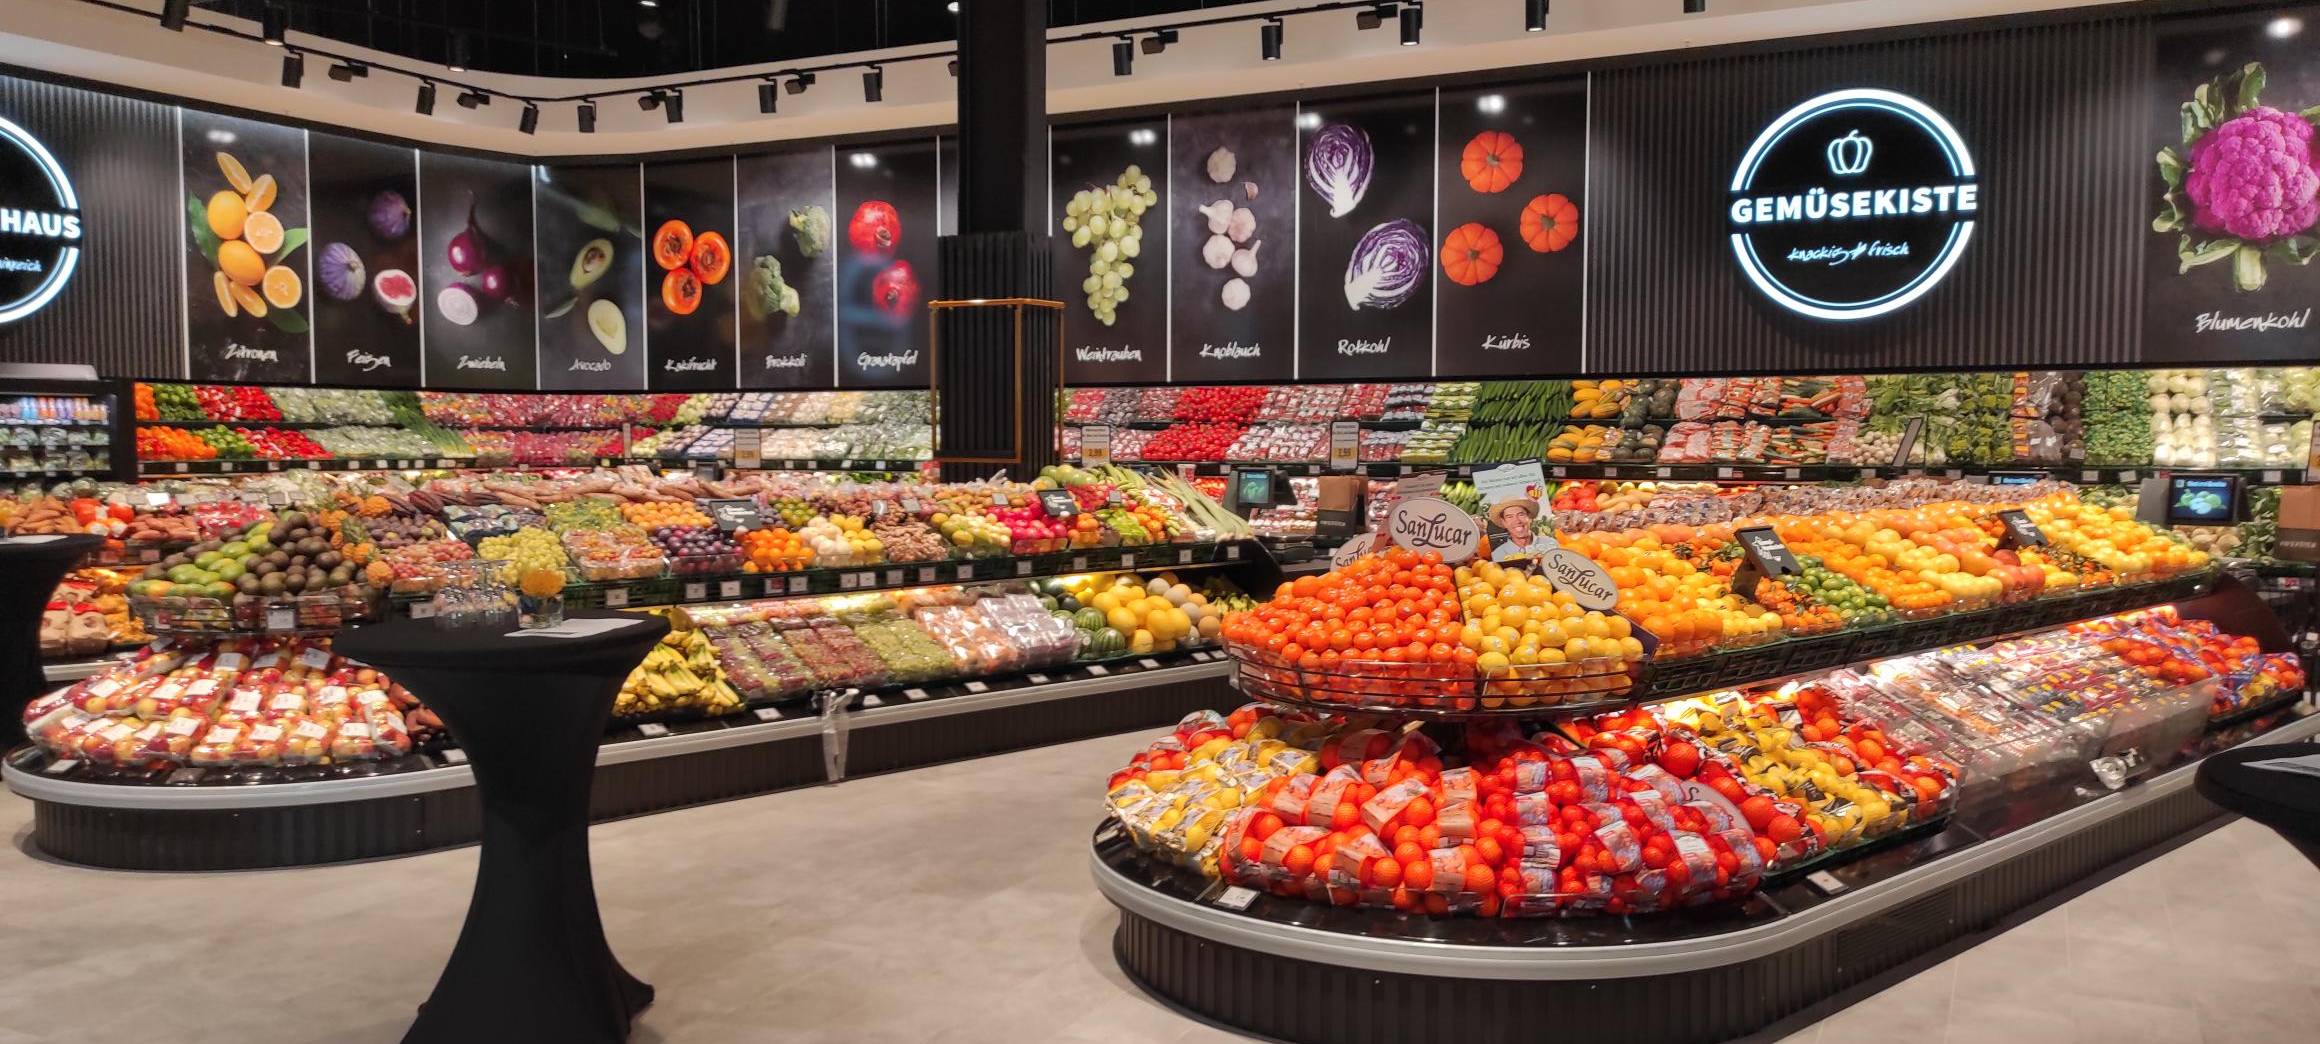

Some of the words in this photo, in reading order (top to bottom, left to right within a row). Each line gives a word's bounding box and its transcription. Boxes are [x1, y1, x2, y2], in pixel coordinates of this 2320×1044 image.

[1731, 184, 1978, 224] GEMÜSEKISTE
[0, 207, 81, 239] HAUS
[2195, 308, 2311, 333] Blumenkohl
[224, 343, 279, 362] Zitronen
[1076, 344, 1142, 362] Weintrauben
[1199, 341, 1261, 359] Knoblauch
[1481, 333, 1531, 350] Kürbis
[347, 349, 392, 372] Feigen
[456, 355, 507, 371] Zwiebeln
[1396, 510, 1472, 548] SanLucar
[1548, 553, 1614, 601] SanLucar
